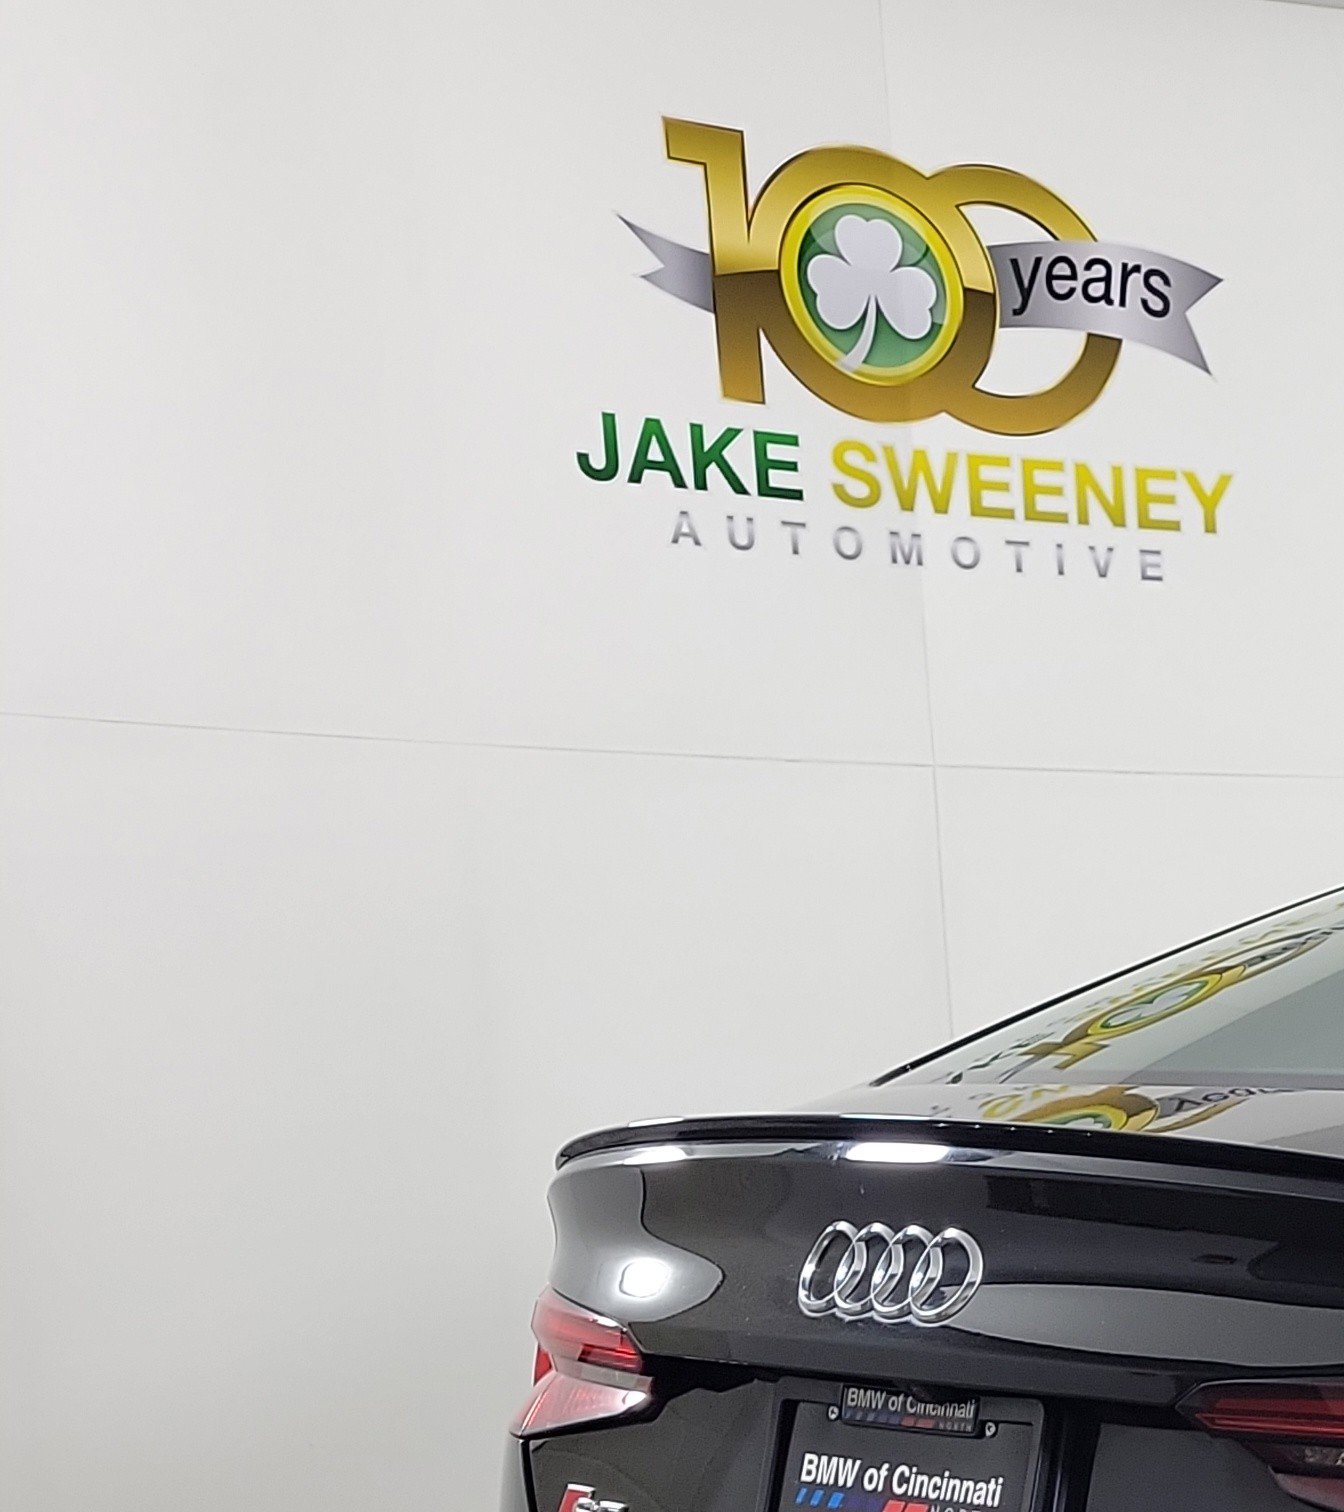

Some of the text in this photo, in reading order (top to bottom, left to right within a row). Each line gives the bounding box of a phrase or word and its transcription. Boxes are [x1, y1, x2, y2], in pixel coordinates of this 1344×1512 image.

[660, 115, 1123, 437] 100
[1008, 253, 1171, 318] years
[576, 411, 1233, 534] JAKE SWEENEY
[670, 510, 1164, 582] AUTOMOTIVE
[847, 1387, 976, 1419] BMW of Cincinnati
[800, 1452, 1004, 1508] BMW of Cincinnati
